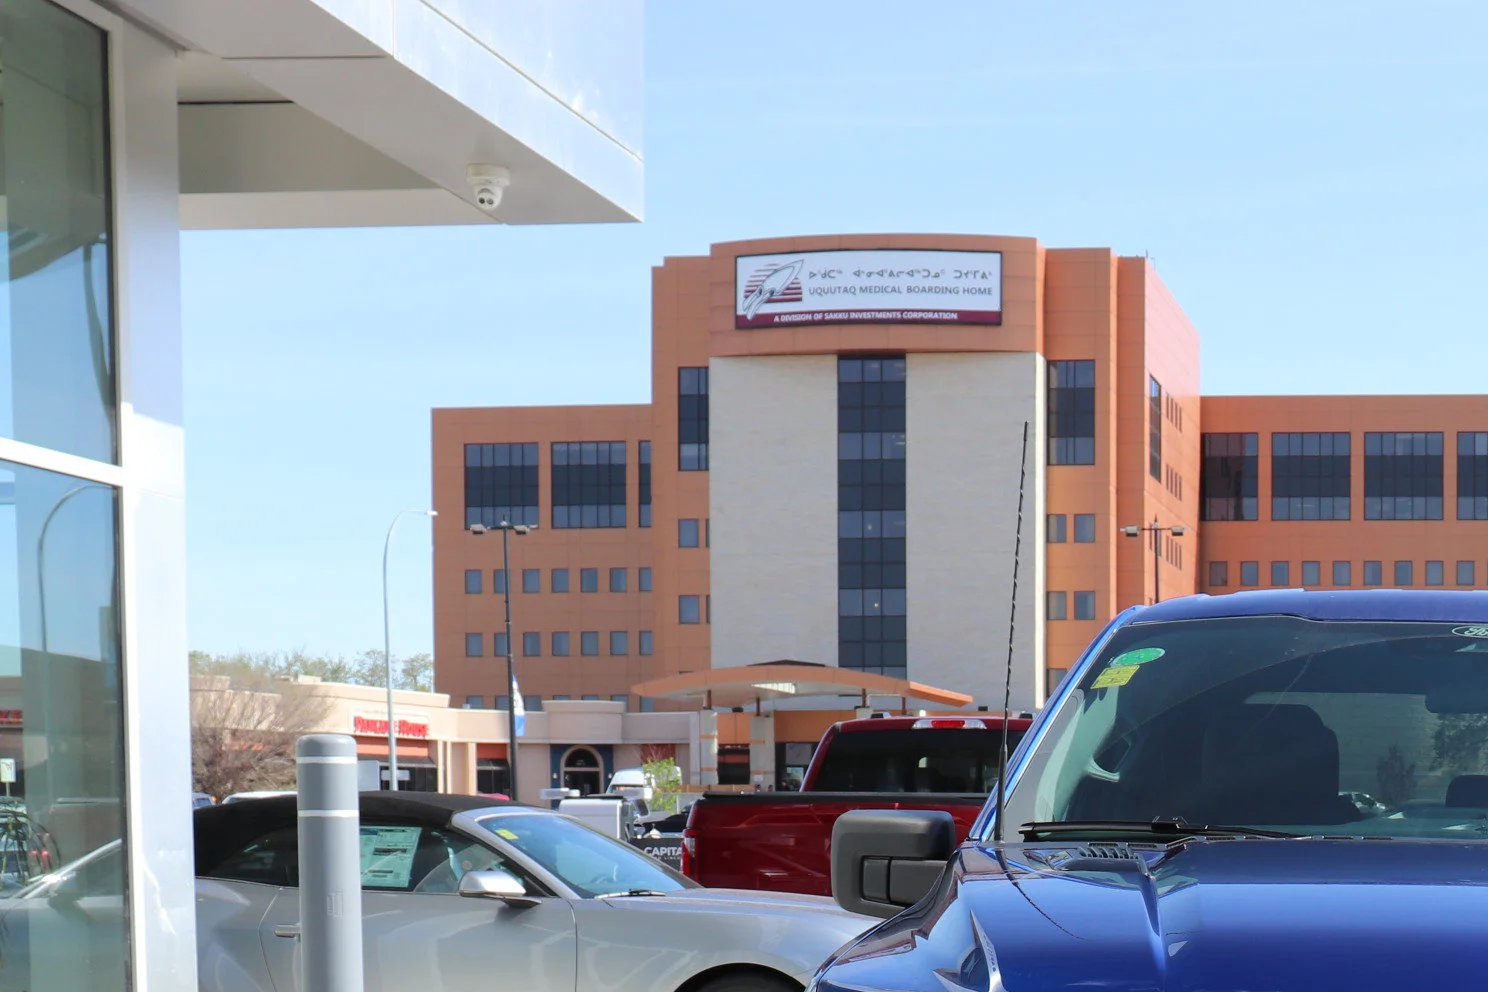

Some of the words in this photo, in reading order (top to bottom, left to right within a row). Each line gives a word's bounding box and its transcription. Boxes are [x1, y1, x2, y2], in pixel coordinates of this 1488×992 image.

[860, 285, 902, 294] MEDICAL
[906, 285, 960, 295] BOARDING
[962, 286, 993, 296] HOME
[781, 313, 812, 322] DIVISION
[813, 312, 823, 321] OF
[824, 312, 849, 320] SAKKU
[849, 311, 901, 320] INVESTMENTS
[902, 311, 958, 320] CORPORATION
